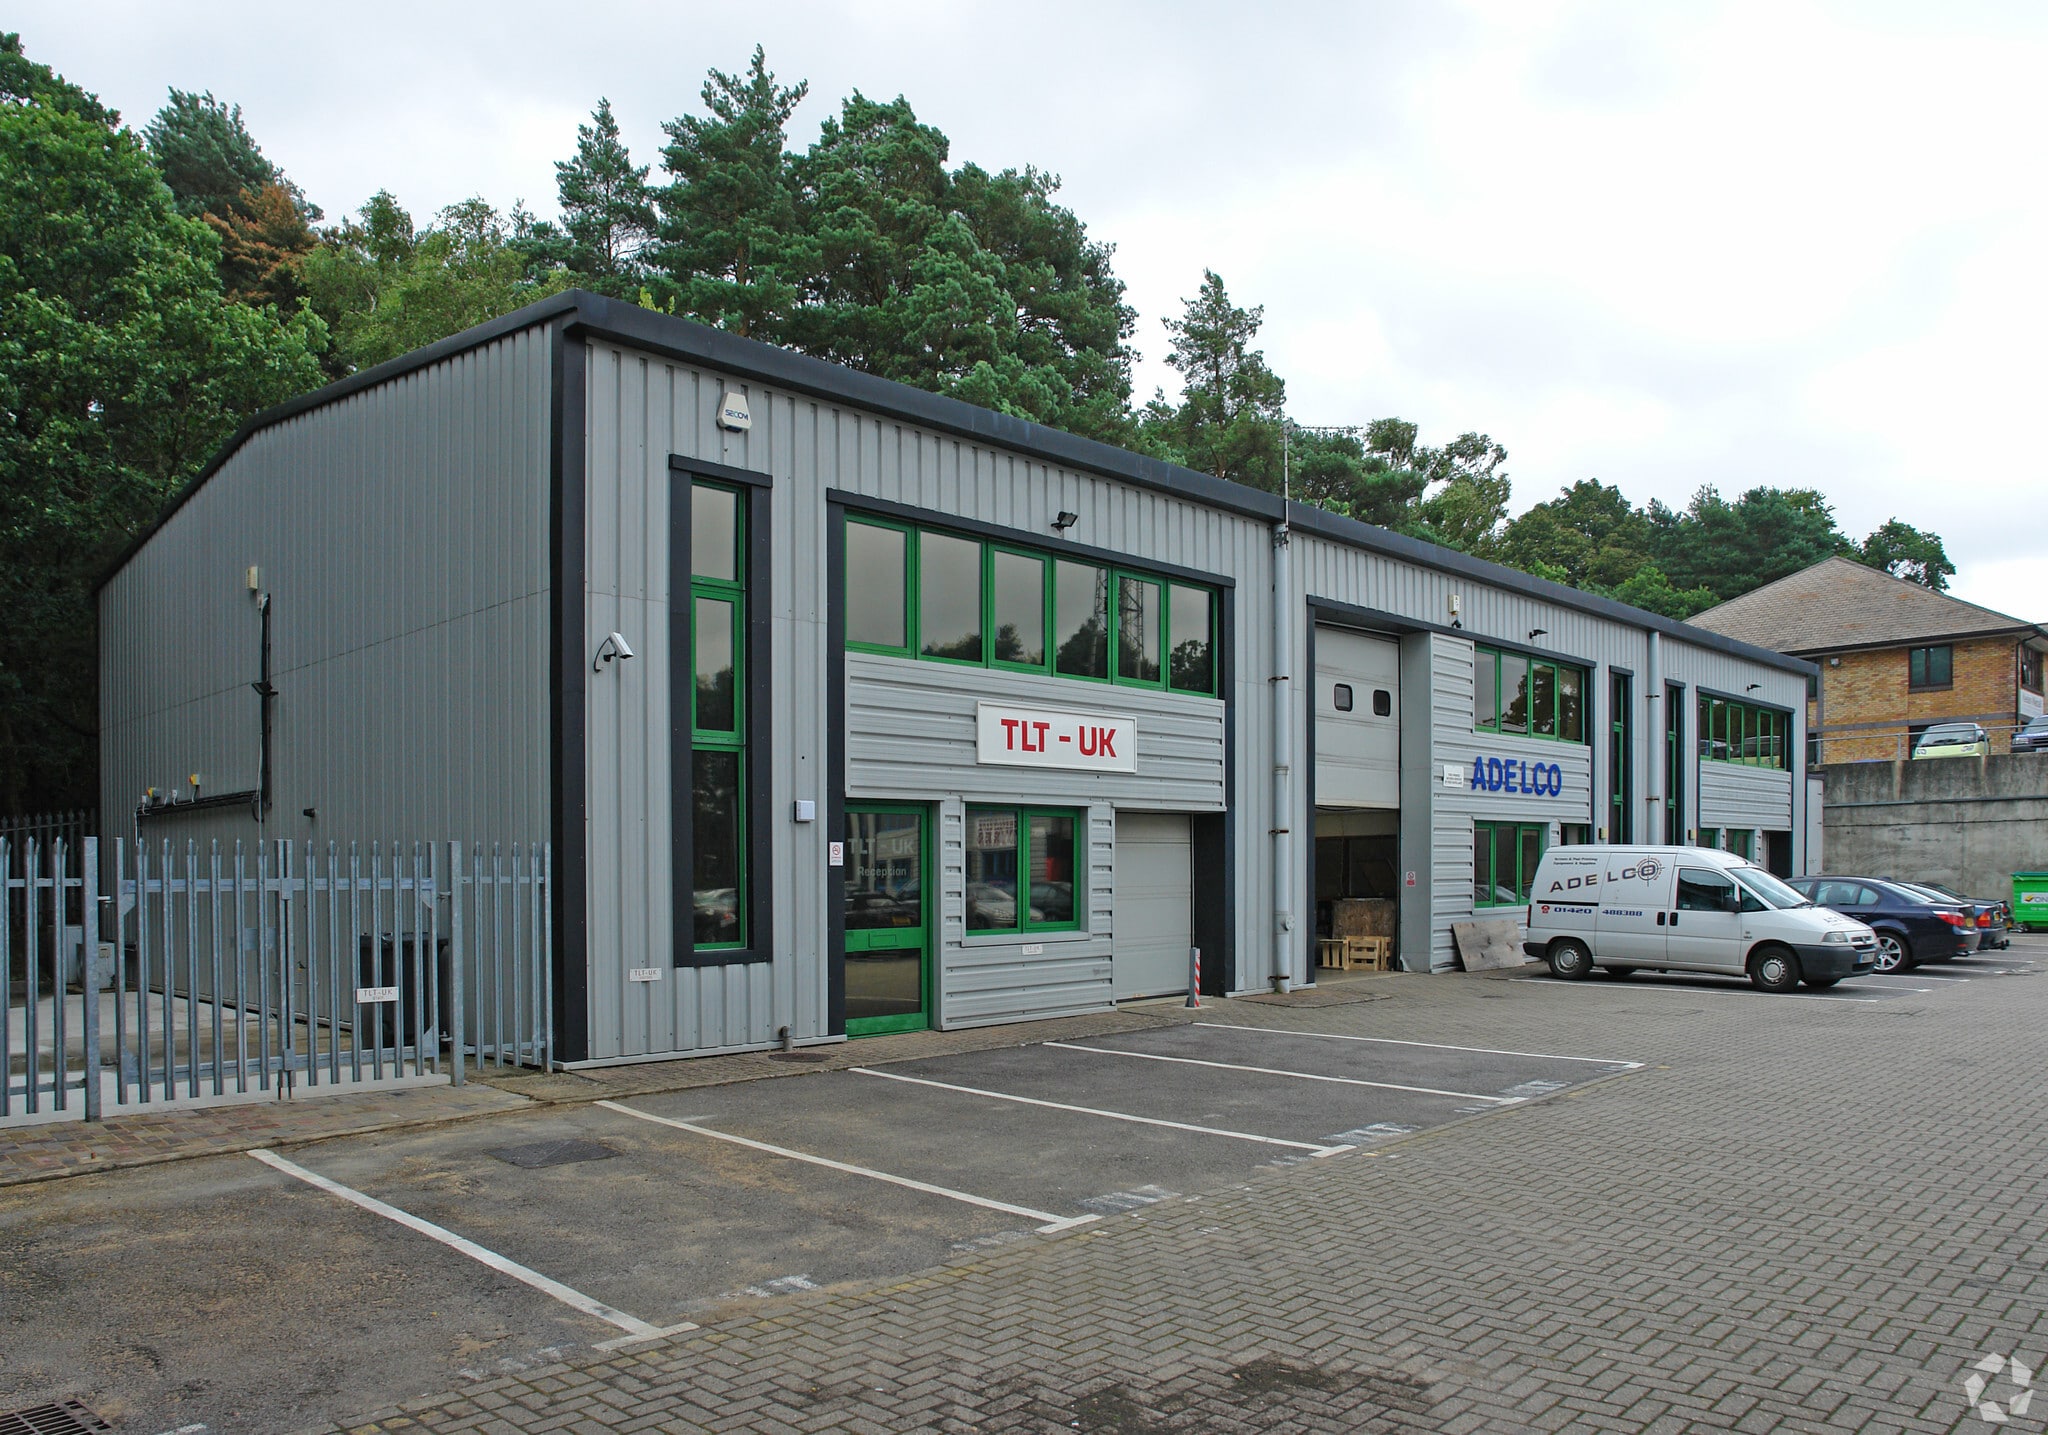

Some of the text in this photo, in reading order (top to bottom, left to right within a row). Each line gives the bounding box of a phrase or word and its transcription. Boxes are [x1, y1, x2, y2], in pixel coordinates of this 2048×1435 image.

[725, 408, 749, 421] SECOM
[1000, 718, 1051, 753] TLT
[1078, 725, 1118, 758] UK
[1471, 755, 1563, 797] ADELCO
[847, 838, 875, 855] TLT
[892, 838, 914, 854] UK
[857, 866, 907, 879] Reception
[1549, 864, 1656, 893] ADELCO
